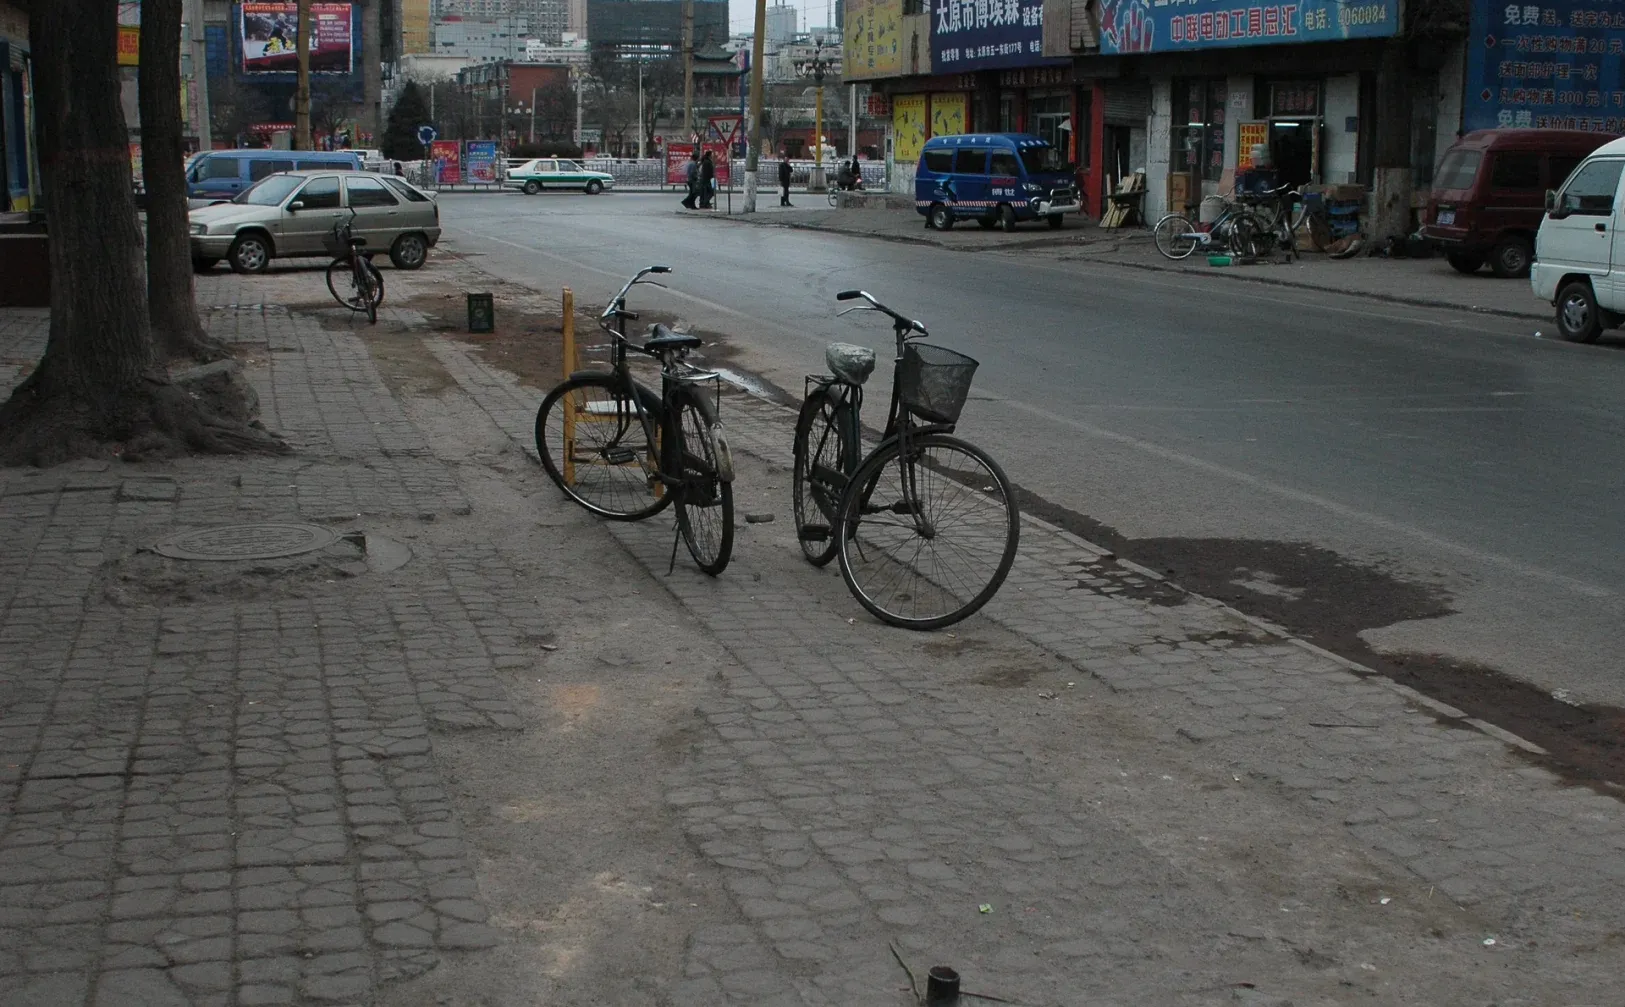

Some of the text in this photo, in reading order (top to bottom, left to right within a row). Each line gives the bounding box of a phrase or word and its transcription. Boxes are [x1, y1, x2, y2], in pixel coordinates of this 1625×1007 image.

[1171, 6, 1296, 42] 中联电动工具总汇
[1498, 60, 1598, 80] 送面部护理一次
